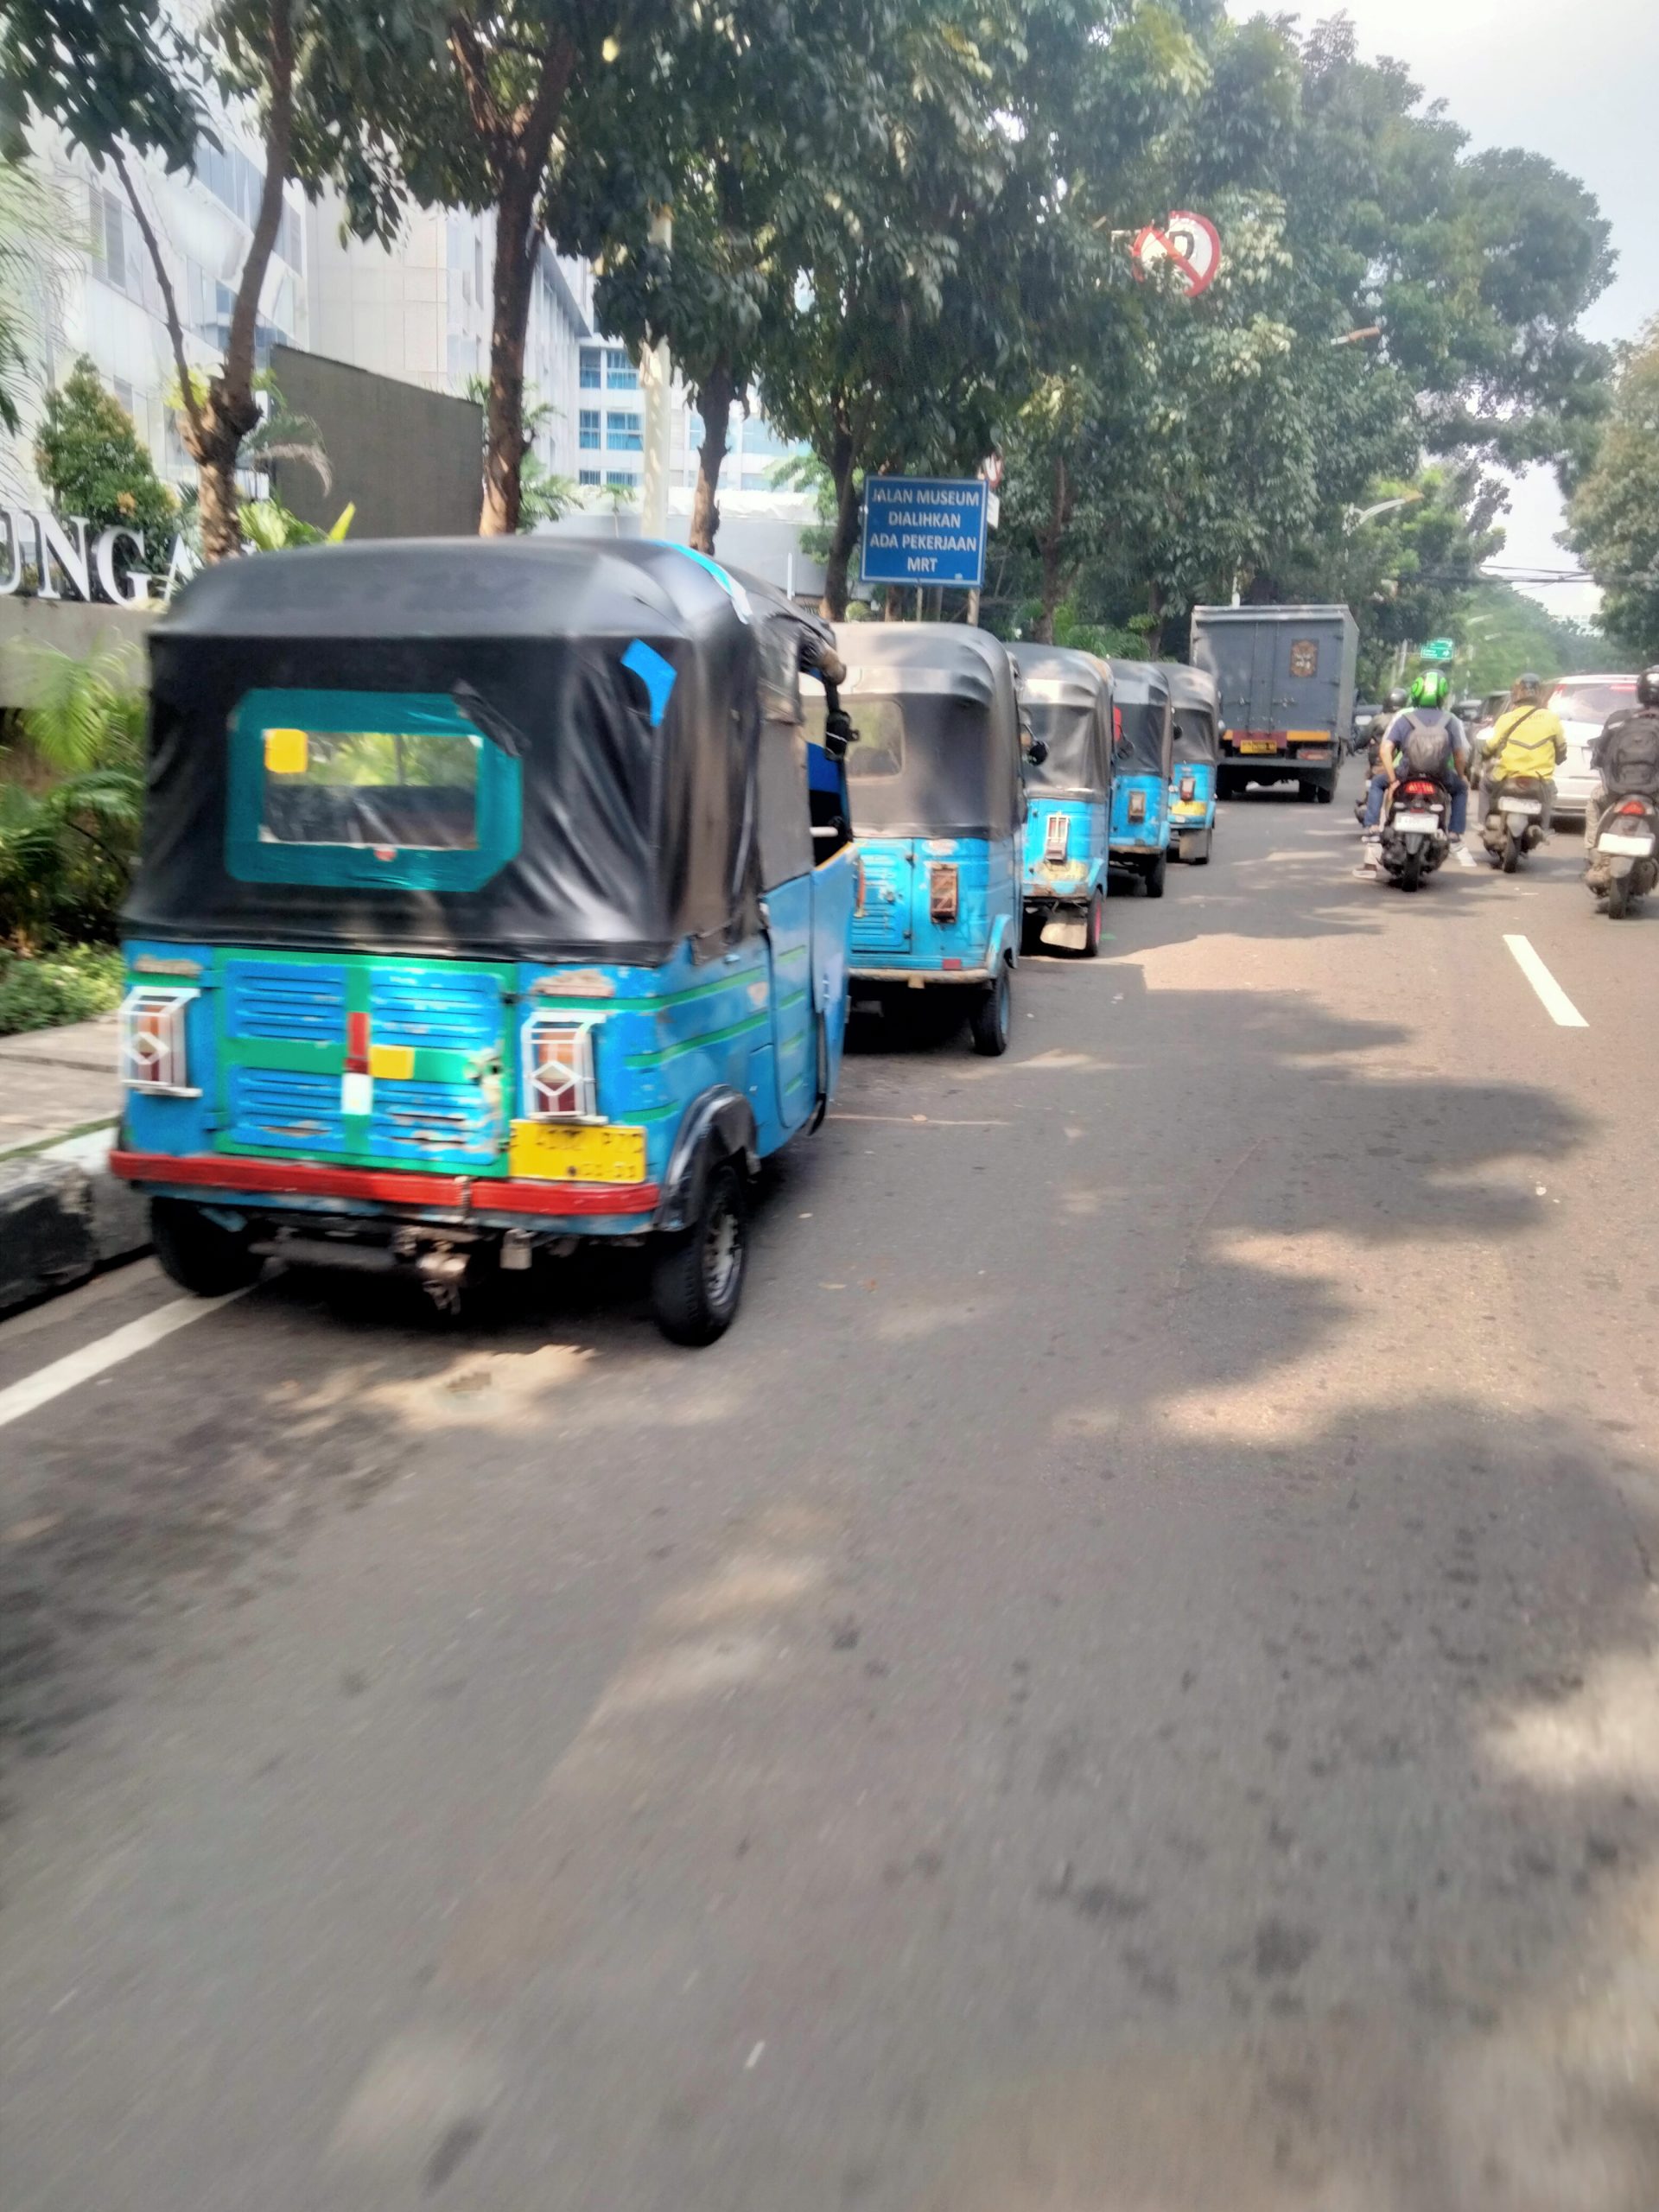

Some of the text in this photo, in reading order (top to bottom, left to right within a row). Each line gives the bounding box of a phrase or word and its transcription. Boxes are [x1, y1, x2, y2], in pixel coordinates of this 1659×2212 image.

[872, 487, 979, 506] JALAN MUSEUM
[888, 511, 961, 529] DIALIHKAN
[870, 533, 977, 552] ADA PEKERJAAN
[907, 556, 938, 573] MRT
